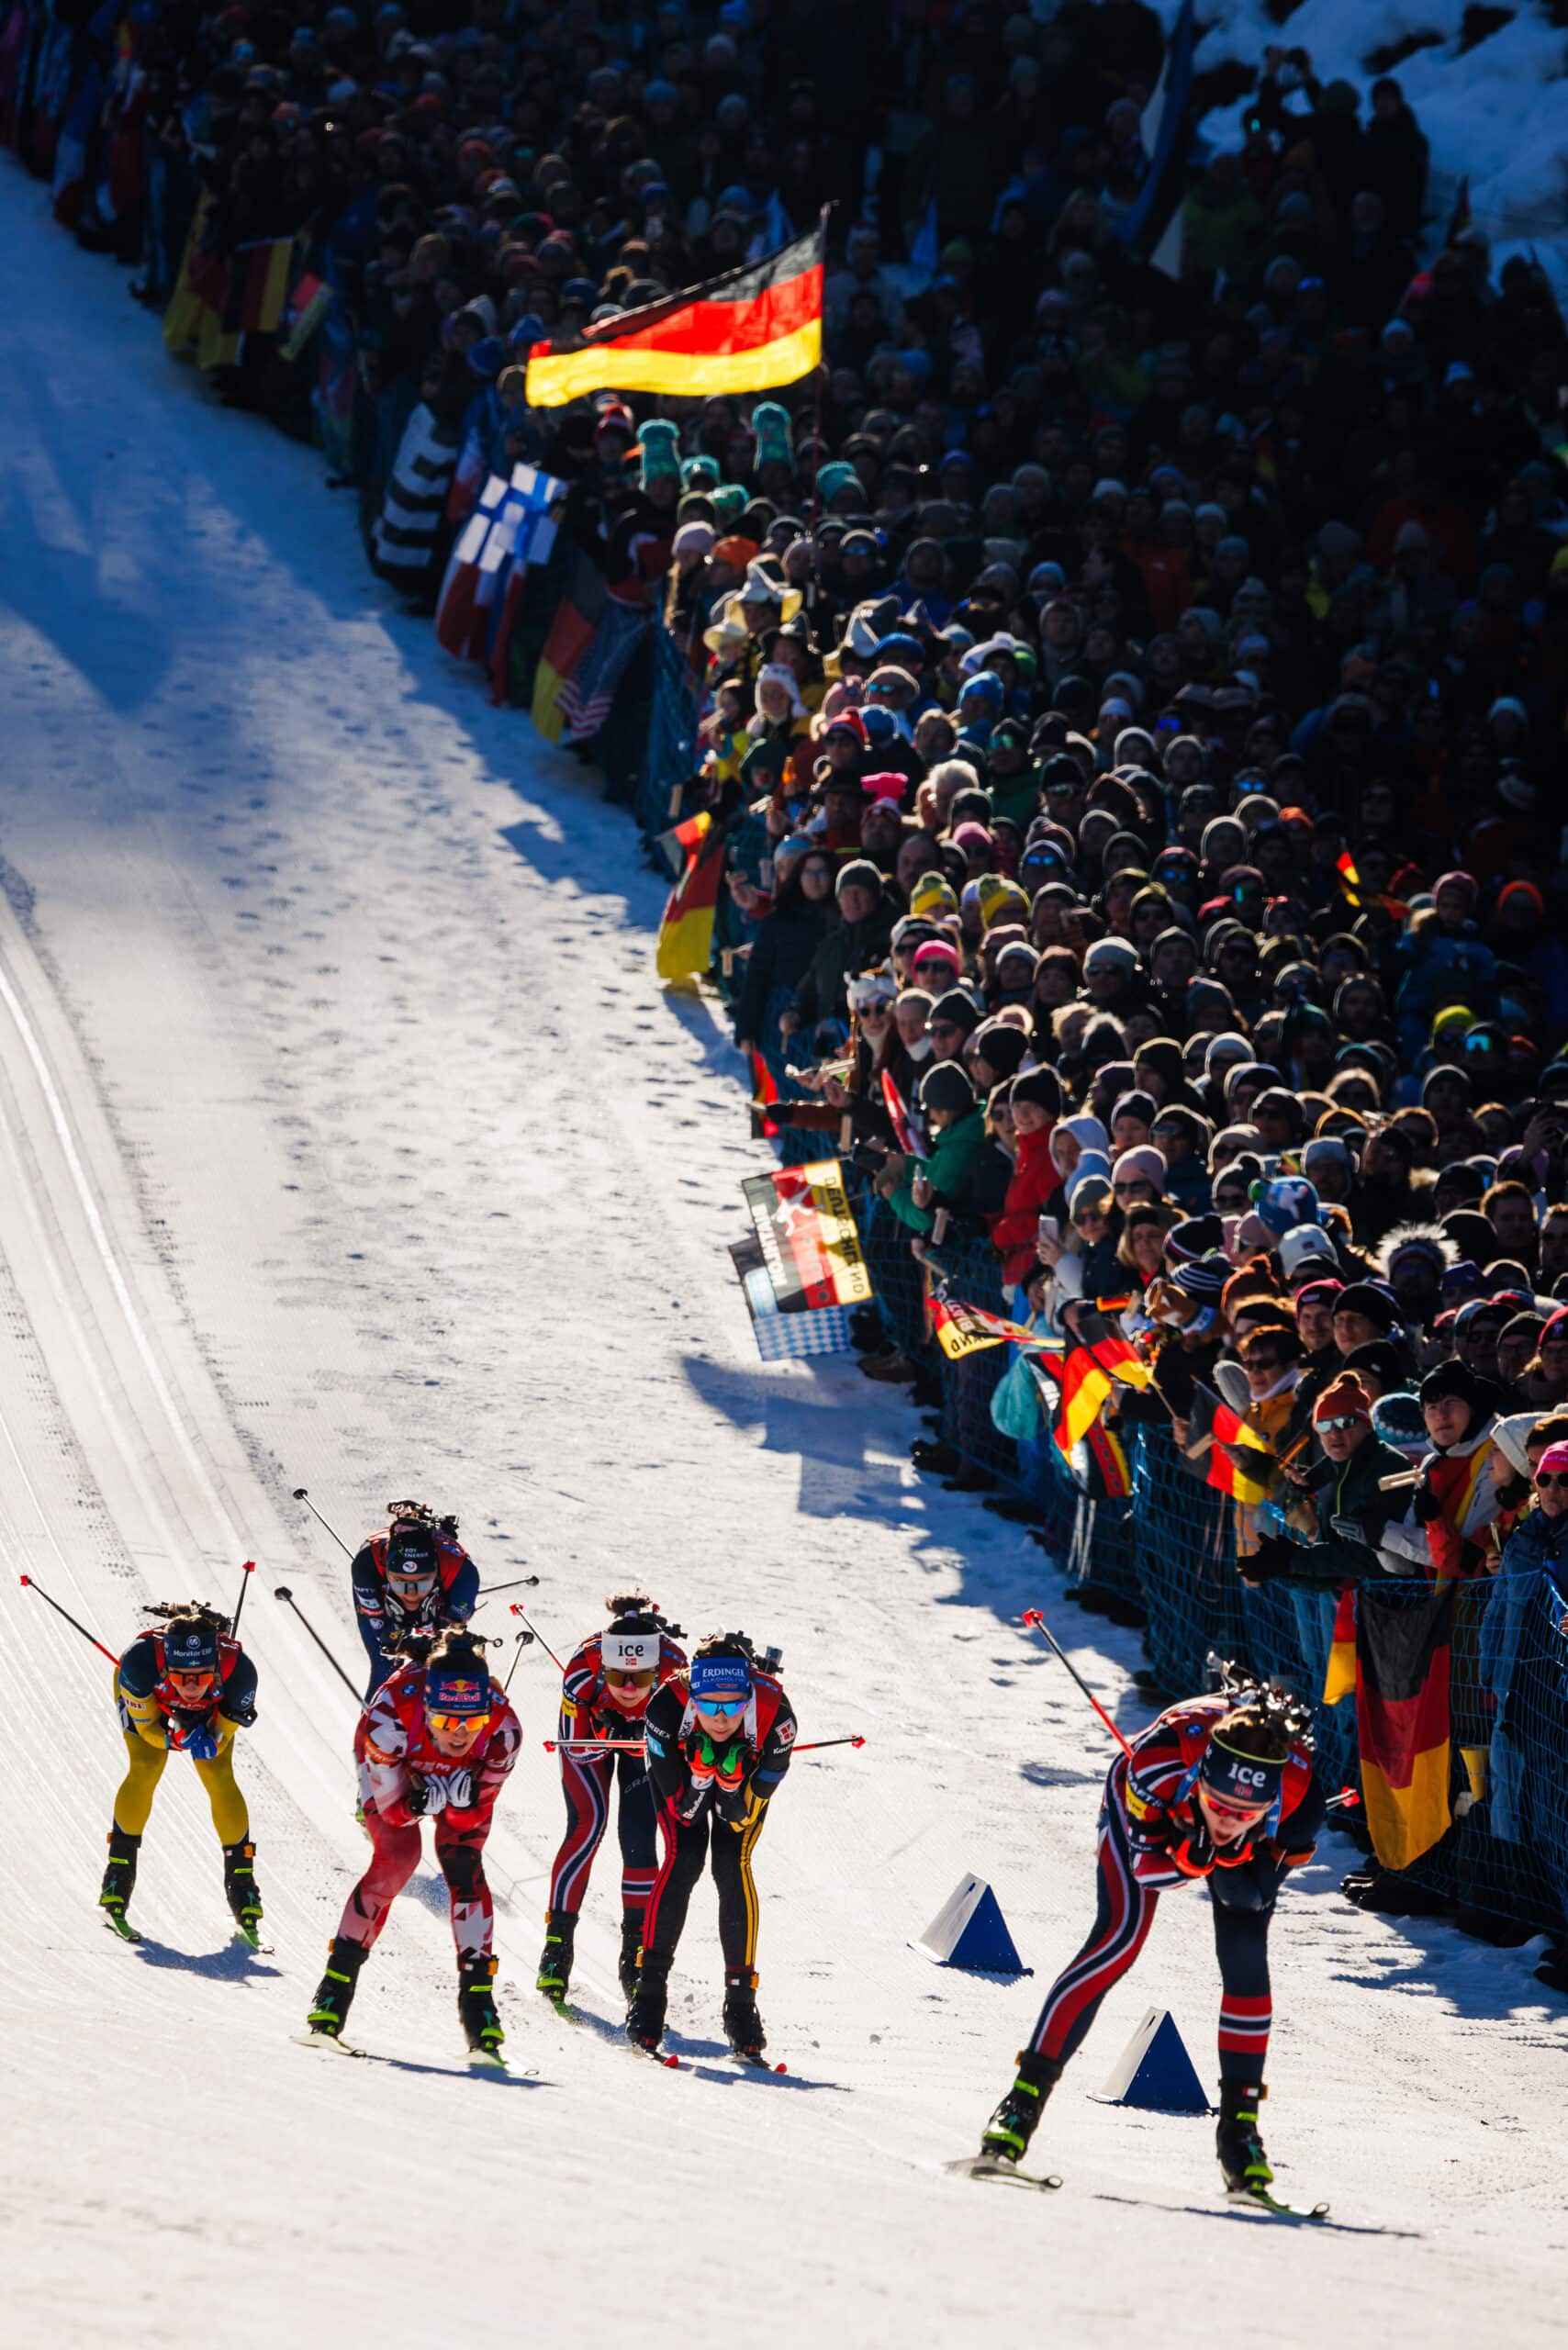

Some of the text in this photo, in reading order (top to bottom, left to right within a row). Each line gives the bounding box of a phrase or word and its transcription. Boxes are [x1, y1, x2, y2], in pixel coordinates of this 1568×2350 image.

[173, 1649, 201, 1657] Monitor
[618, 1642, 644, 1658] ice
[702, 1667, 745, 1677] ERDINGER
[438, 1691, 482, 1702] Red Bull
